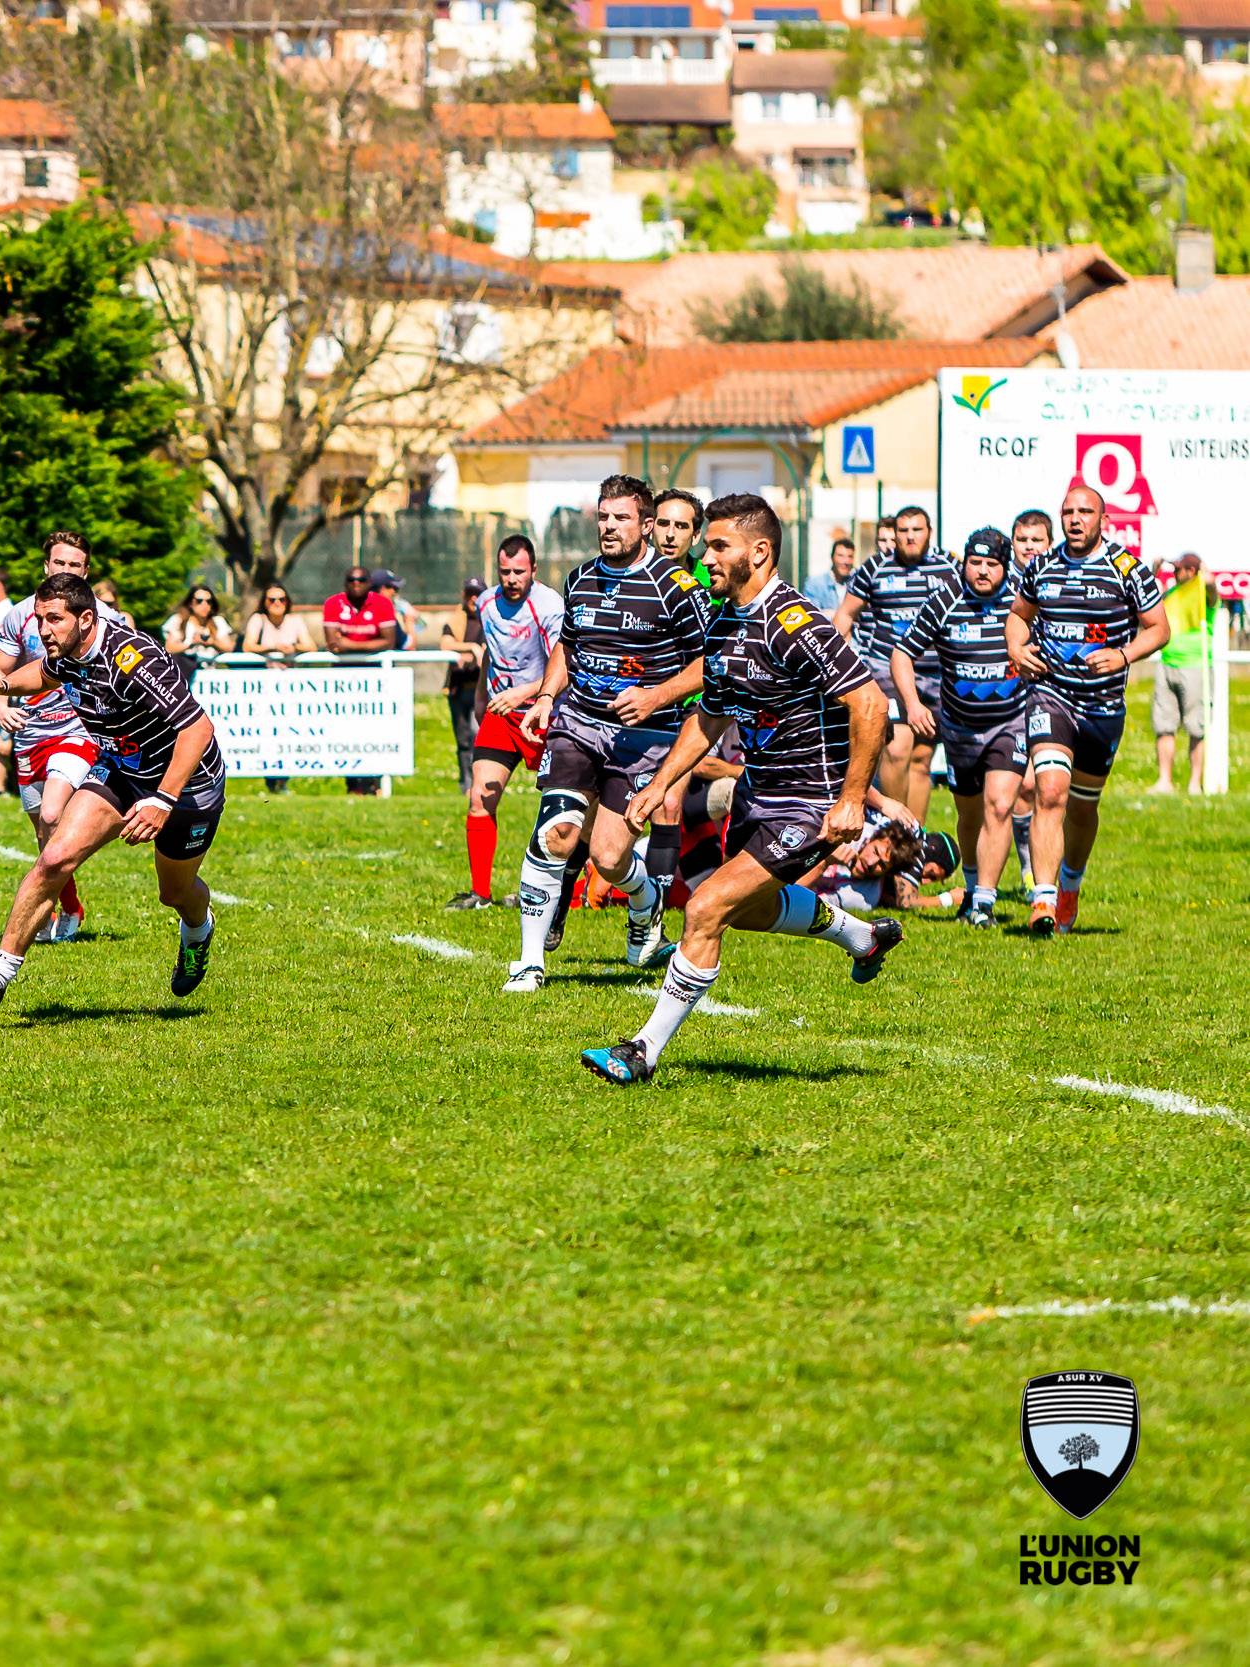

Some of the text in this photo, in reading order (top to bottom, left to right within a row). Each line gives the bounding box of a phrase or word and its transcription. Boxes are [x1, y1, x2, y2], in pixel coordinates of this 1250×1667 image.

[979, 437, 1040, 457] RCQF
[1169, 438, 1250, 459] VISITEURS
[1081, 441, 1142, 513] Q
[1086, 623, 1107, 643] 35
[136, 666, 178, 705] RENAULT
[243, 681, 264, 695] DE
[267, 702, 400, 716] AUTOMOBILE
[276, 742, 322, 754] 31400
